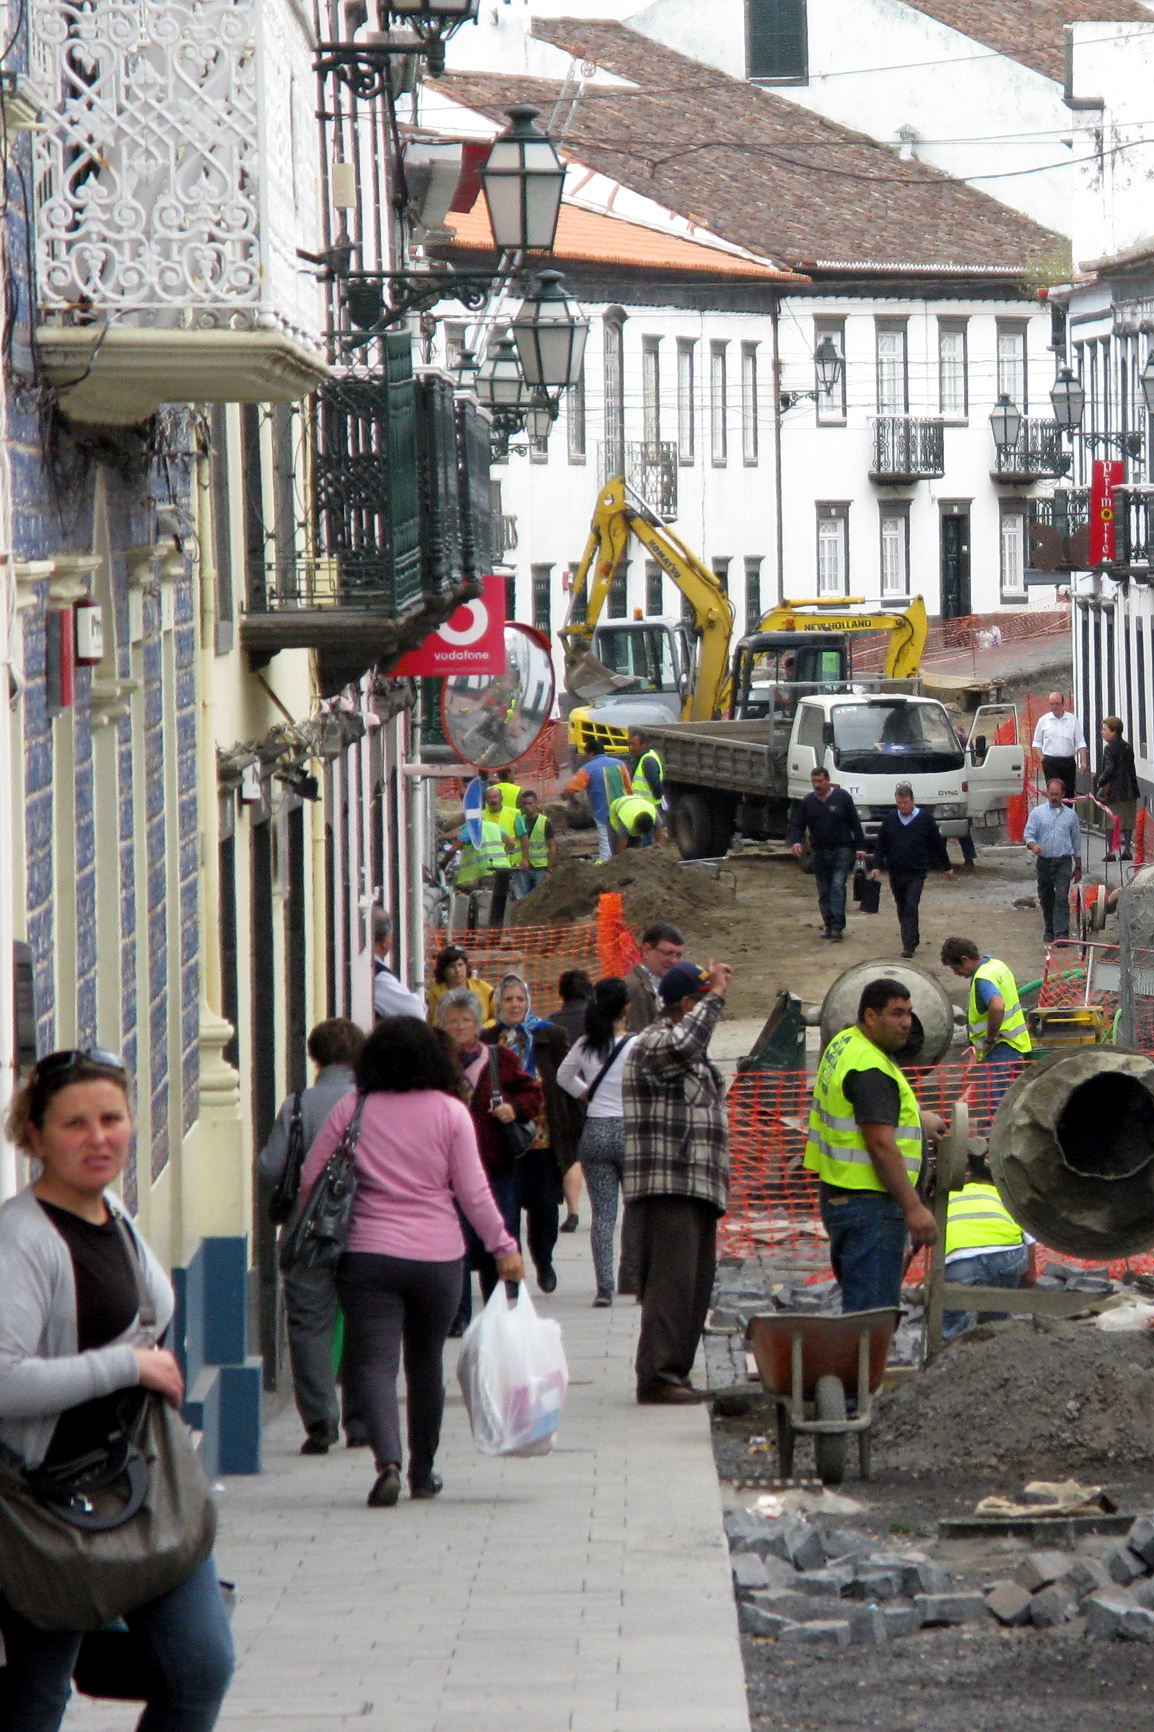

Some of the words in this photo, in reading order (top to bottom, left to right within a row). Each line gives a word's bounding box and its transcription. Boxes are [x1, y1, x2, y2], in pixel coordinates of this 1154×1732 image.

[649, 539, 681, 578] KOMATSU
[828, 619, 871, 631] HOLLAND
[434, 650, 489, 660] vodafone
